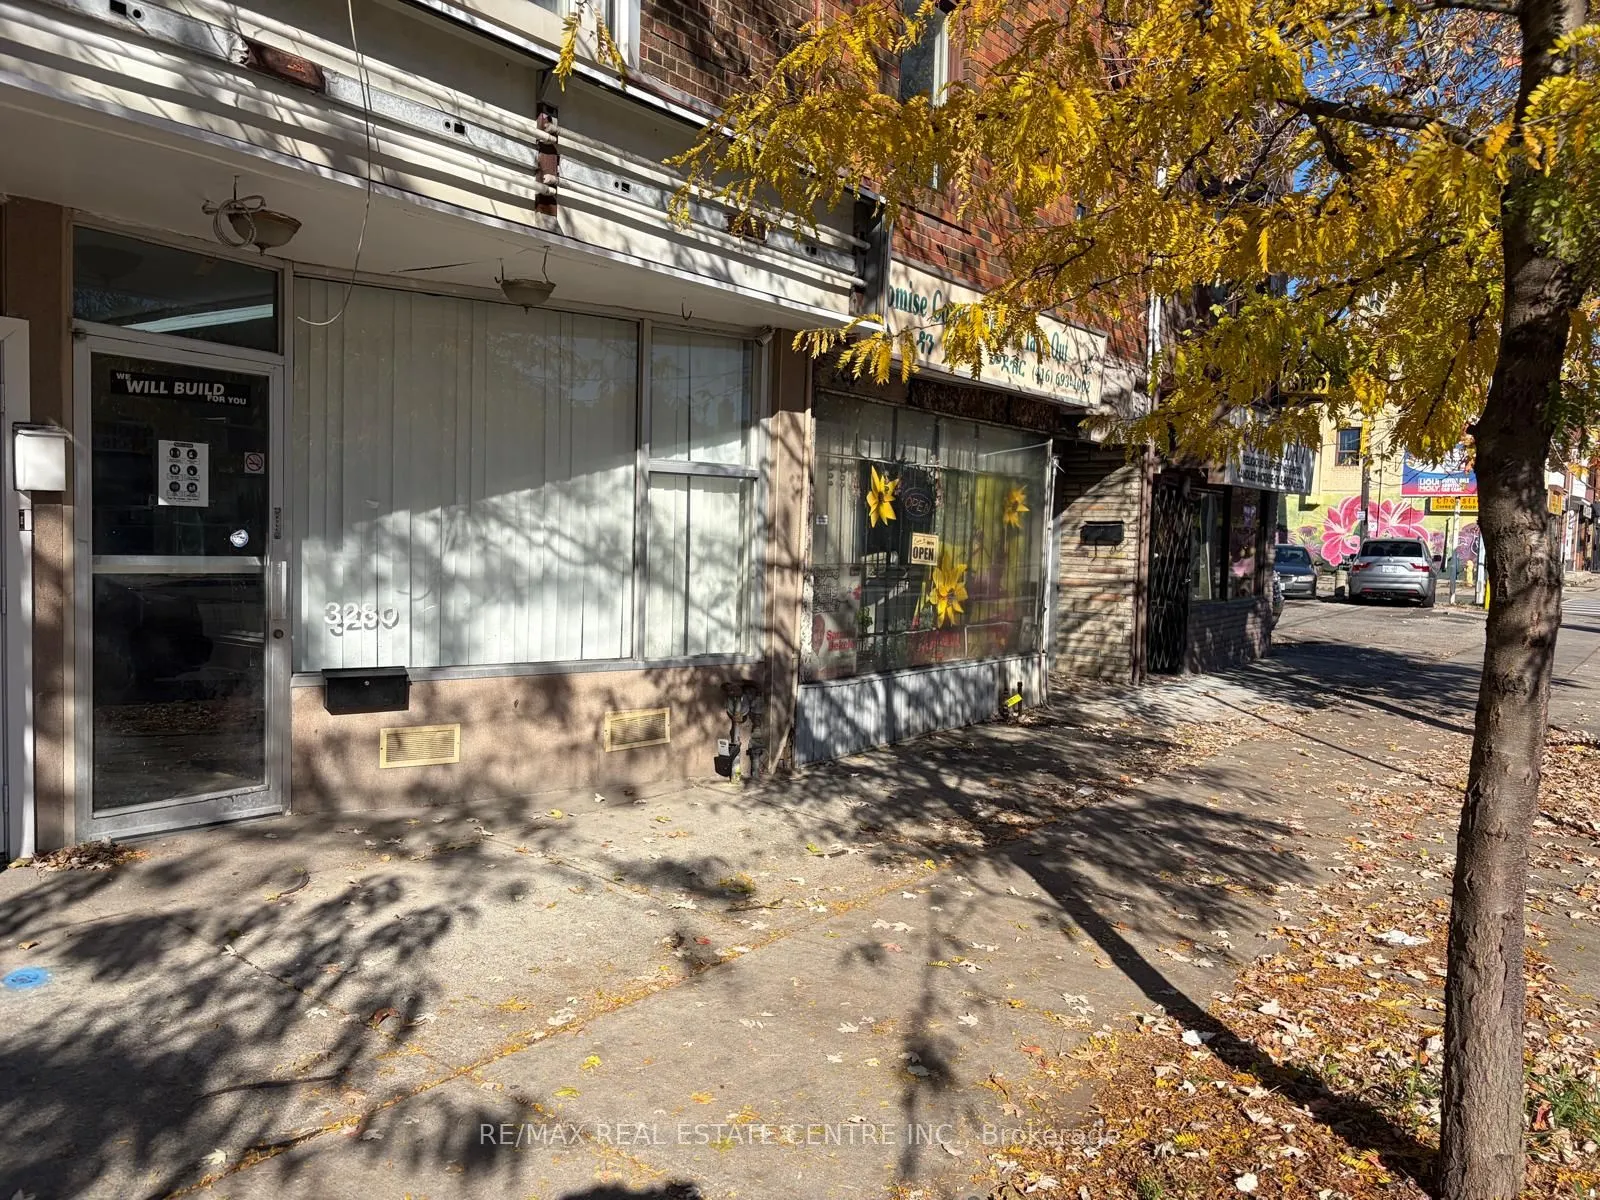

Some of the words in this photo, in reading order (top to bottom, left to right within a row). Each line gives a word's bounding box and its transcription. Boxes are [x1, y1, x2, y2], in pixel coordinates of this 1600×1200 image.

[116, 372, 131, 380] WE
[126, 380, 168, 394] WILL
[173, 381, 225, 396] BUILD
[206, 394, 226, 403] FOR
[228, 396, 247, 405] YOU
[912, 546, 935, 561] OPEN
[324, 602, 399, 627] 3280
